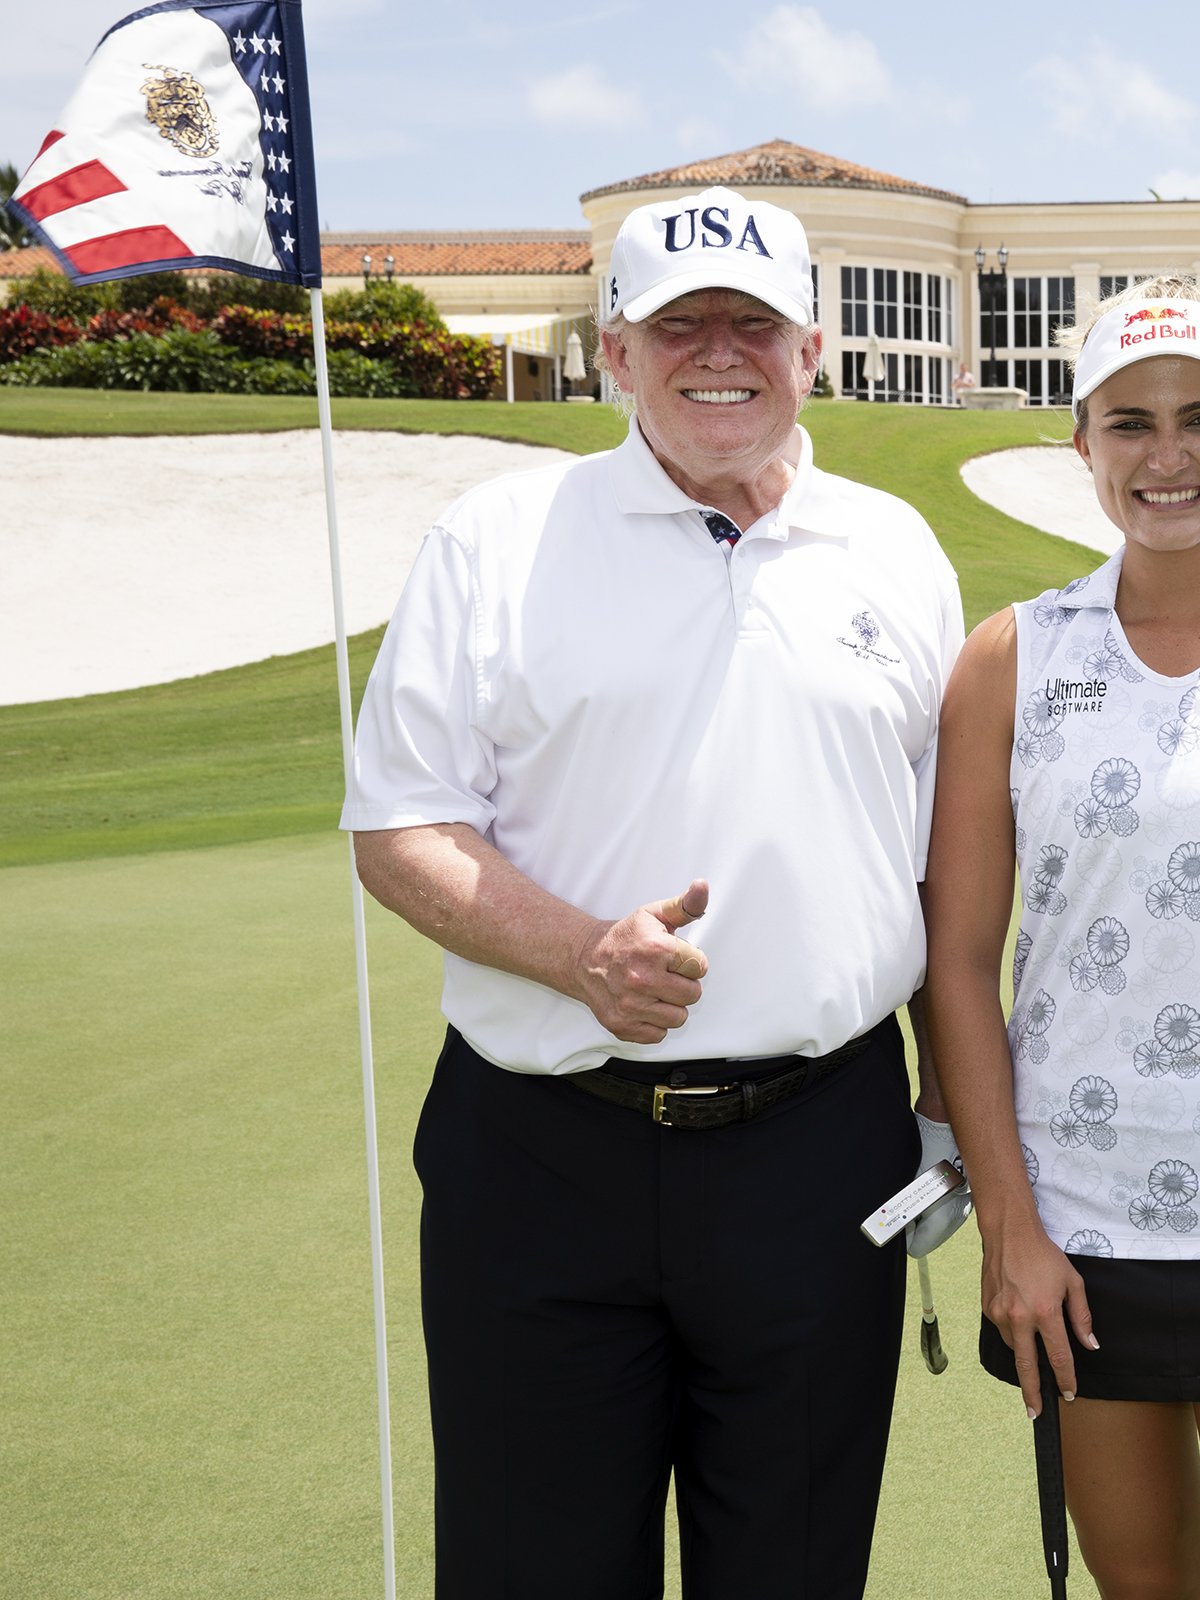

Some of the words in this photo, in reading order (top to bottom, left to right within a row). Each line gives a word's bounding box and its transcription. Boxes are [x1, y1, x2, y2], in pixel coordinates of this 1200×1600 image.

[661, 206, 774, 260] USA
[1120, 325, 1156, 349] Red
[1159, 324, 1196, 340] Bull
[1045, 678, 1107, 701] Ultimate
[1047, 701, 1102, 717] SOFTWARE
